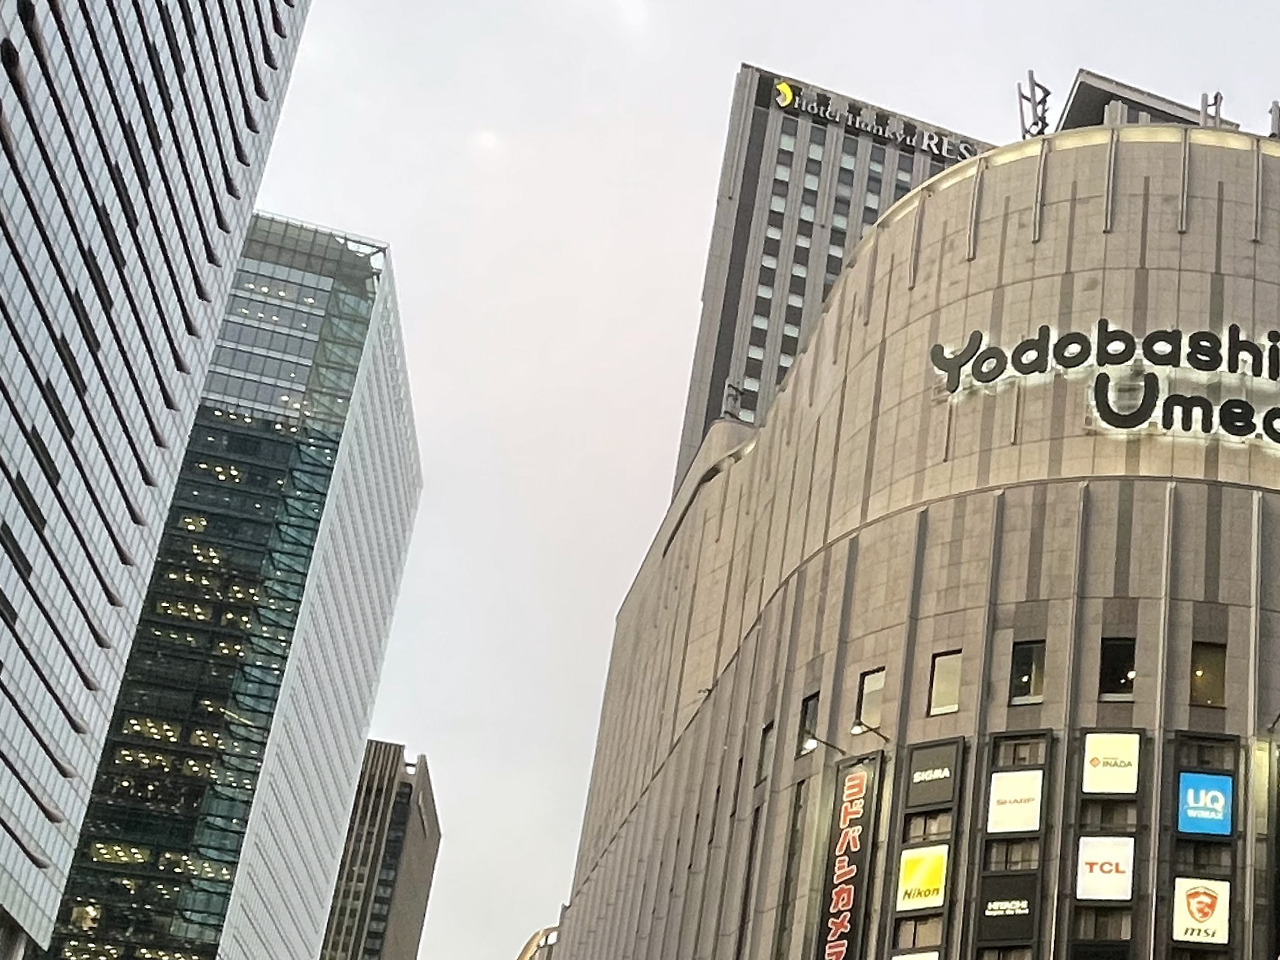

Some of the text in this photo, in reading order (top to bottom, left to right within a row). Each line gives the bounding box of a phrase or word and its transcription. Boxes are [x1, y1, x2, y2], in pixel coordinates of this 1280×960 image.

[794, 93, 841, 123] Hotel
[847, 111, 917, 147] Hankyu
[930, 318, 1280, 394] Yodobashi
[1102, 760, 1133, 768] INADA
[913, 767, 950, 783] SIGMA
[996, 797, 1036, 806] SHARP
[1187, 788, 1225, 812] UQ
[1085, 862, 1126, 874] TCL
[902, 887, 940, 900] Nikon
[1183, 927, 1217, 938] msi
